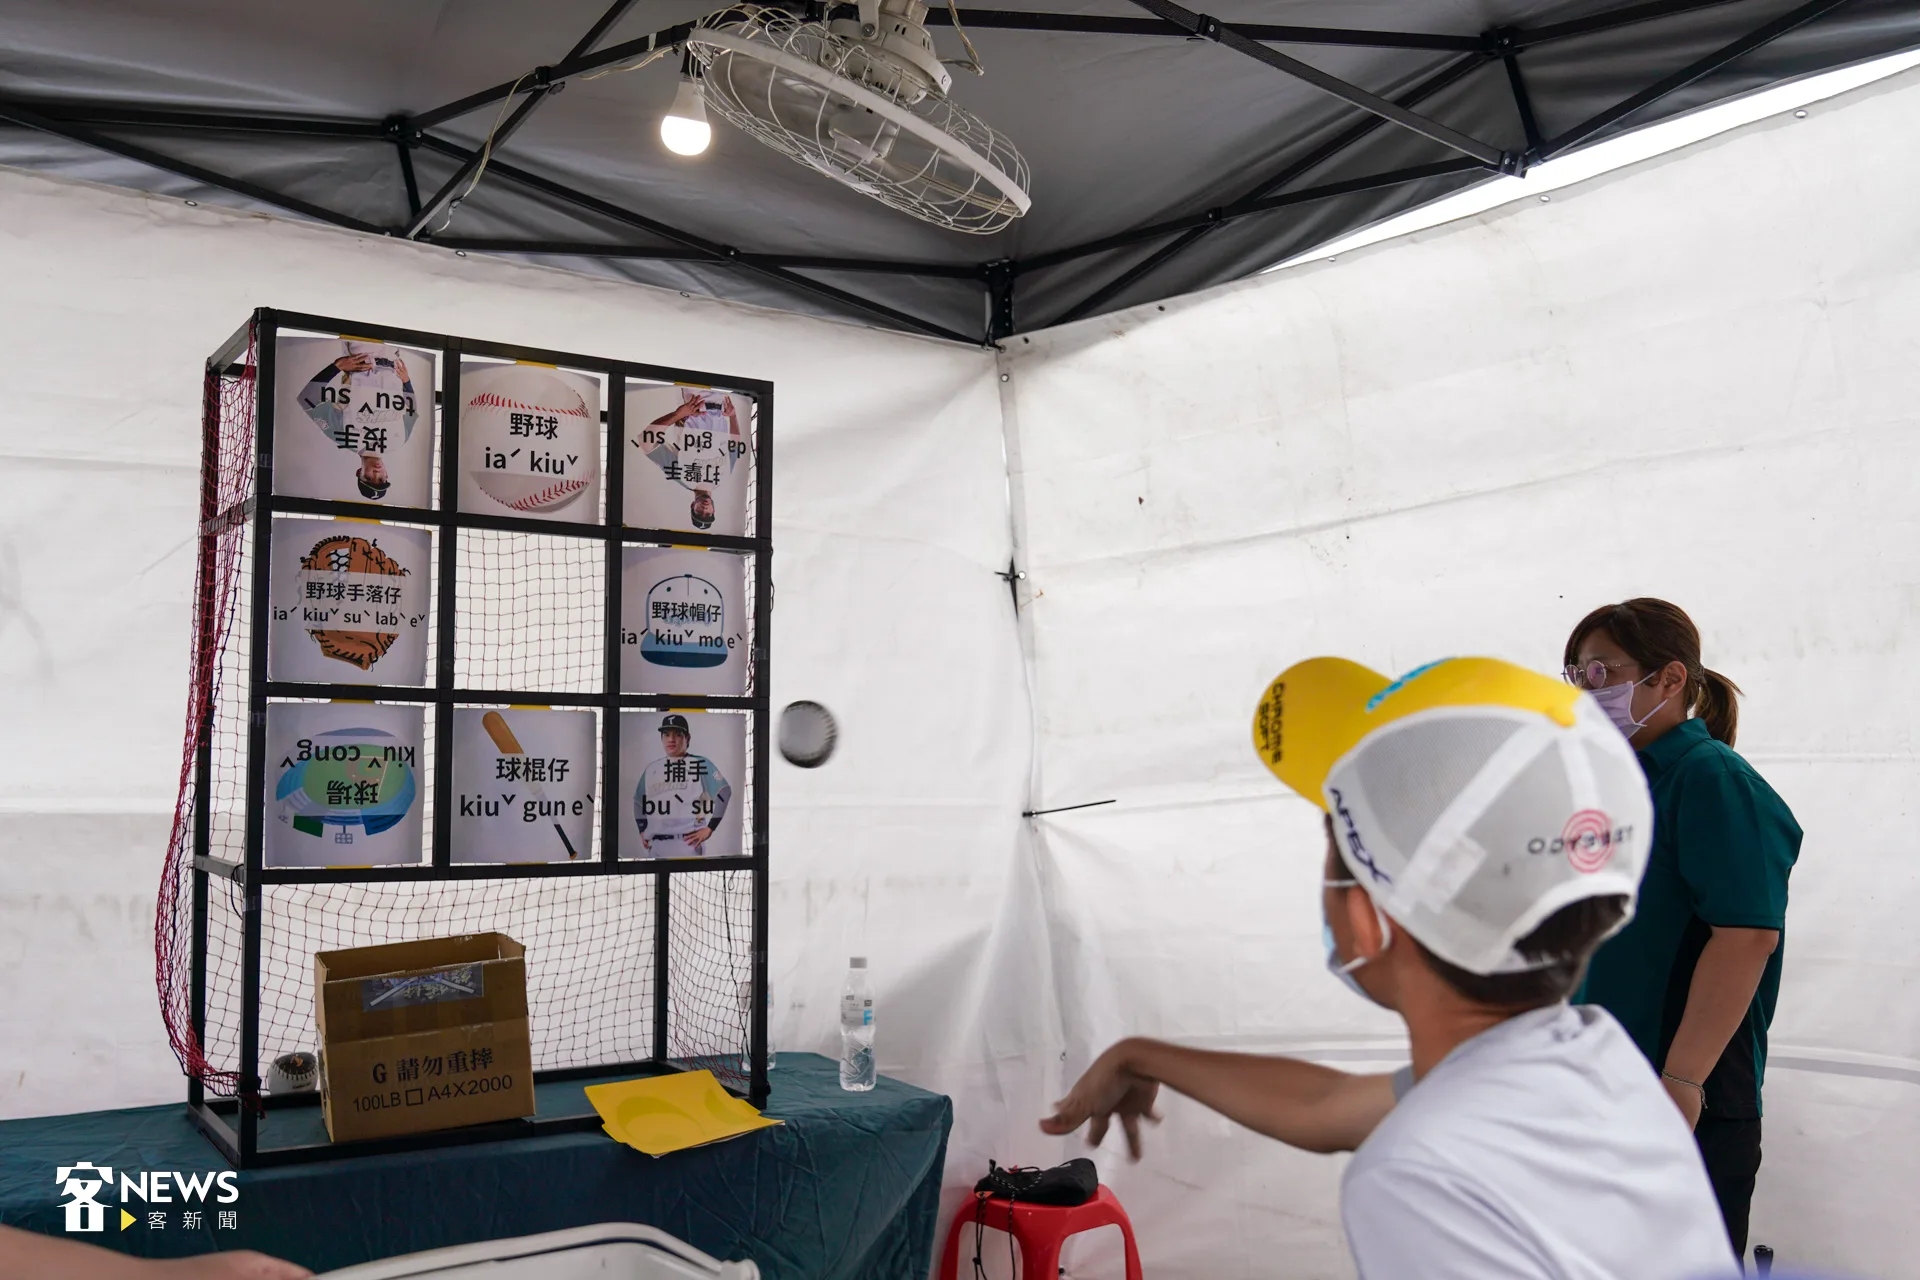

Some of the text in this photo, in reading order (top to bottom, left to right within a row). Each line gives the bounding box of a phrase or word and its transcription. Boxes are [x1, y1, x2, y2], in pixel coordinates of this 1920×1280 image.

[509, 412, 559, 440] 野球
[333, 424, 388, 454] 投手
[663, 460, 720, 485] 打擊手
[305, 581, 402, 604] 野球手落仔
[651, 600, 722, 623] 野球帽仔
[495, 757, 570, 782] 球棍仔
[663, 759, 709, 783] 捕手
[326, 780, 379, 806] 球場
[372, 1047, 493, 1084] G 請勿重摔
